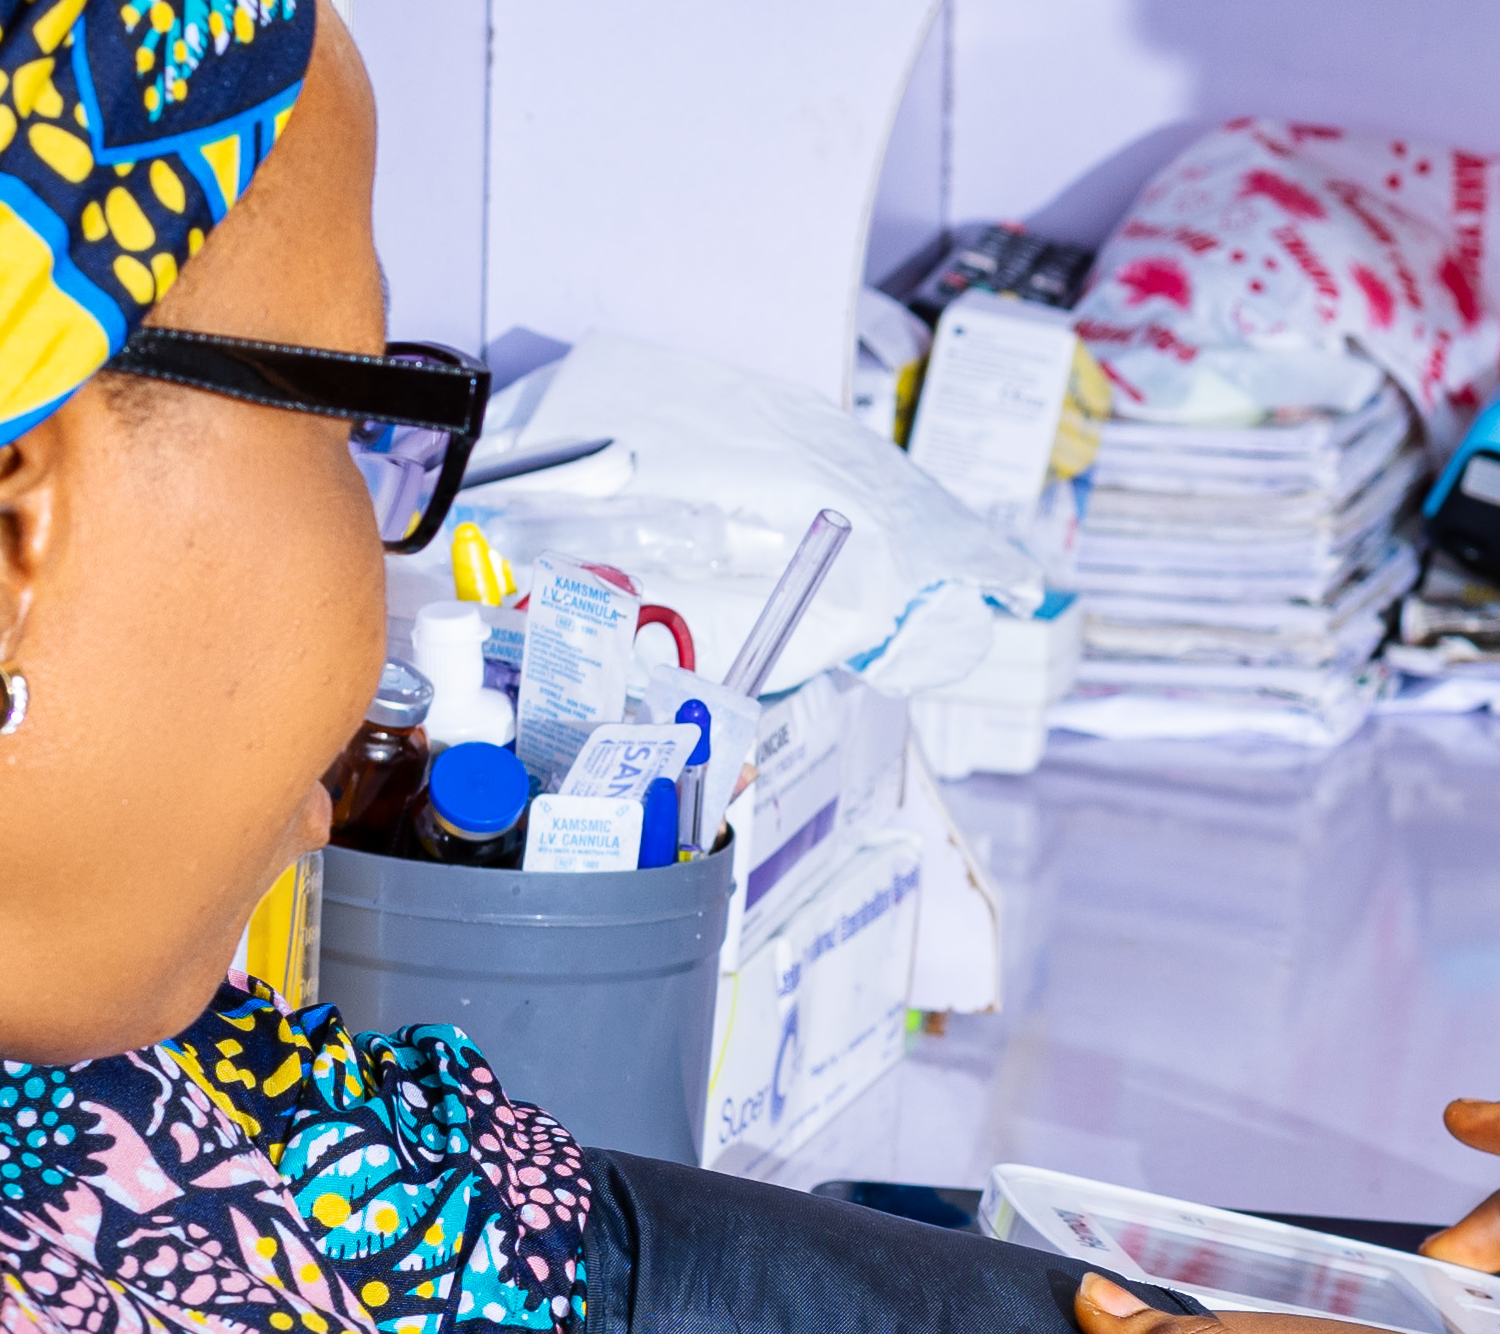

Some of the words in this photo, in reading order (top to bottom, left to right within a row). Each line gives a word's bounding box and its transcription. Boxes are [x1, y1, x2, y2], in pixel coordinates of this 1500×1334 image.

[555, 575, 611, 604] KAMSMIC
[563, 593, 618, 621] CANNULA
[553, 817, 612, 833] KAMSMIC
[562, 833, 620, 848] CANNULA
